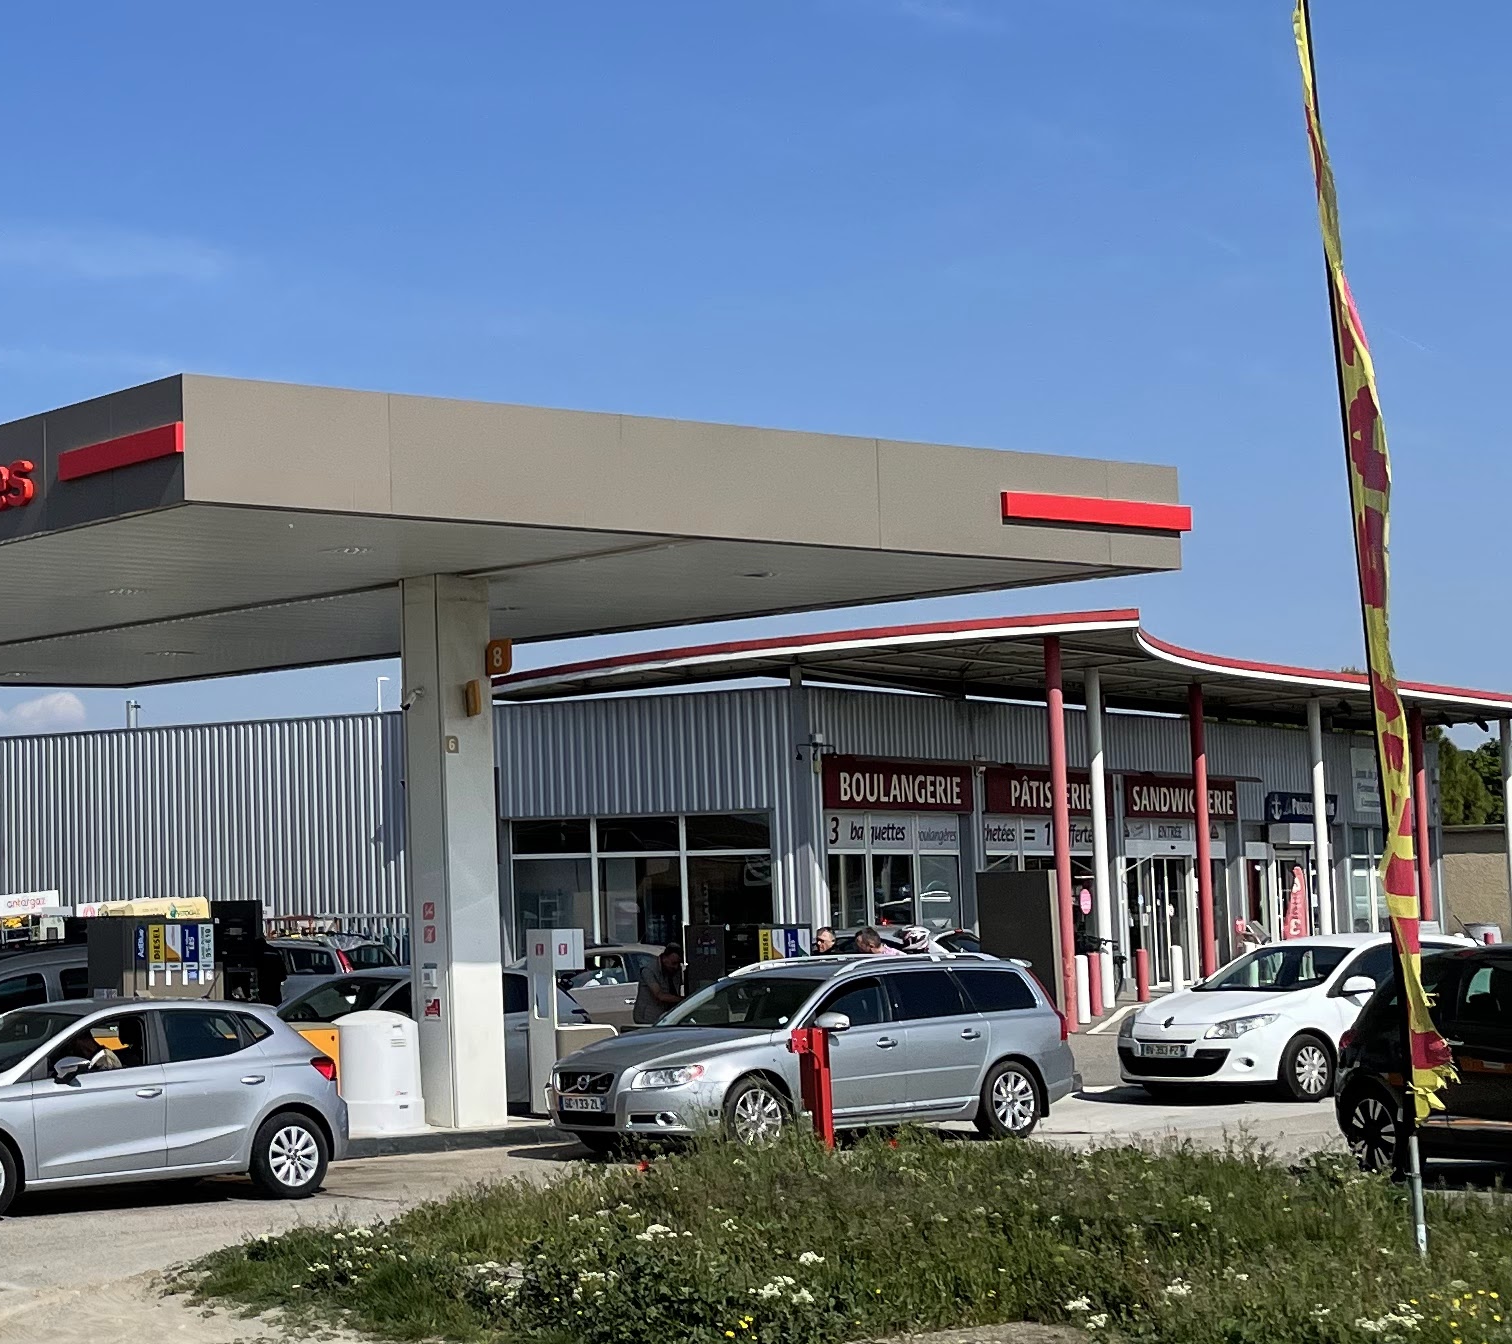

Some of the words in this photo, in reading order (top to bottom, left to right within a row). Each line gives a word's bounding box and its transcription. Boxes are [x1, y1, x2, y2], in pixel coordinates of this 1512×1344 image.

[493, 646, 503, 668] 8
[448, 738, 456, 751] 6
[840, 772, 962, 805] BOULANGERIE
[1010, 775, 1092, 810] PÂTISRIE
[1132, 786, 1234, 815] SANDWICERIE
[829, 816, 839, 845] 3
[1044, 821, 1051, 846] 1
[153, 927, 161, 960] DIESEL
